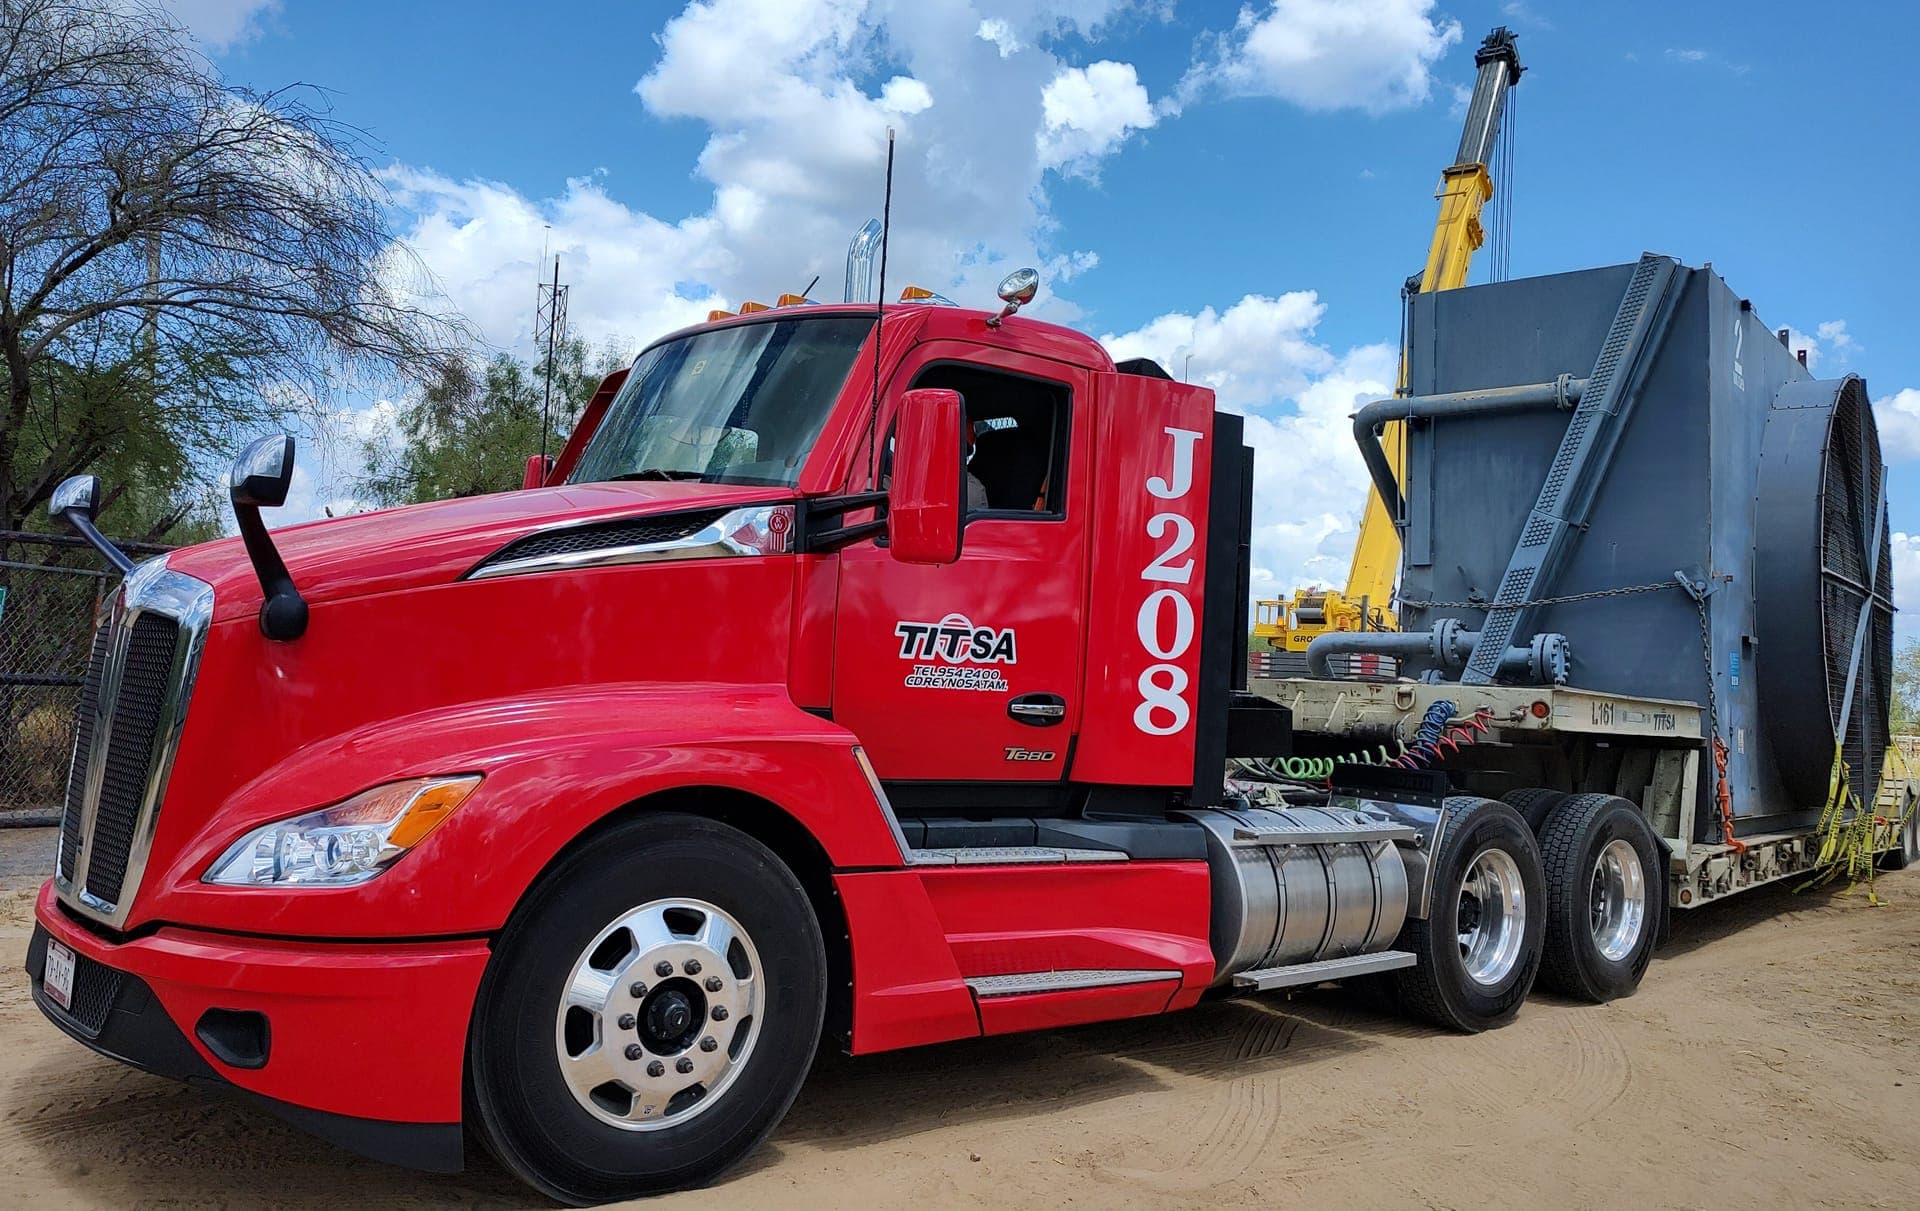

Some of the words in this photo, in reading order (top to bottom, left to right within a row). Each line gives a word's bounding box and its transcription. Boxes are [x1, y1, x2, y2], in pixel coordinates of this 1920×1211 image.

[1133, 426, 1204, 736] J208
[895, 619, 1016, 664] TITSA
[1293, 635, 1317, 643] GRO
[1591, 702, 1615, 726] L161
[1653, 713, 1676, 731] TITSA
[1005, 747, 1056, 761] T680
